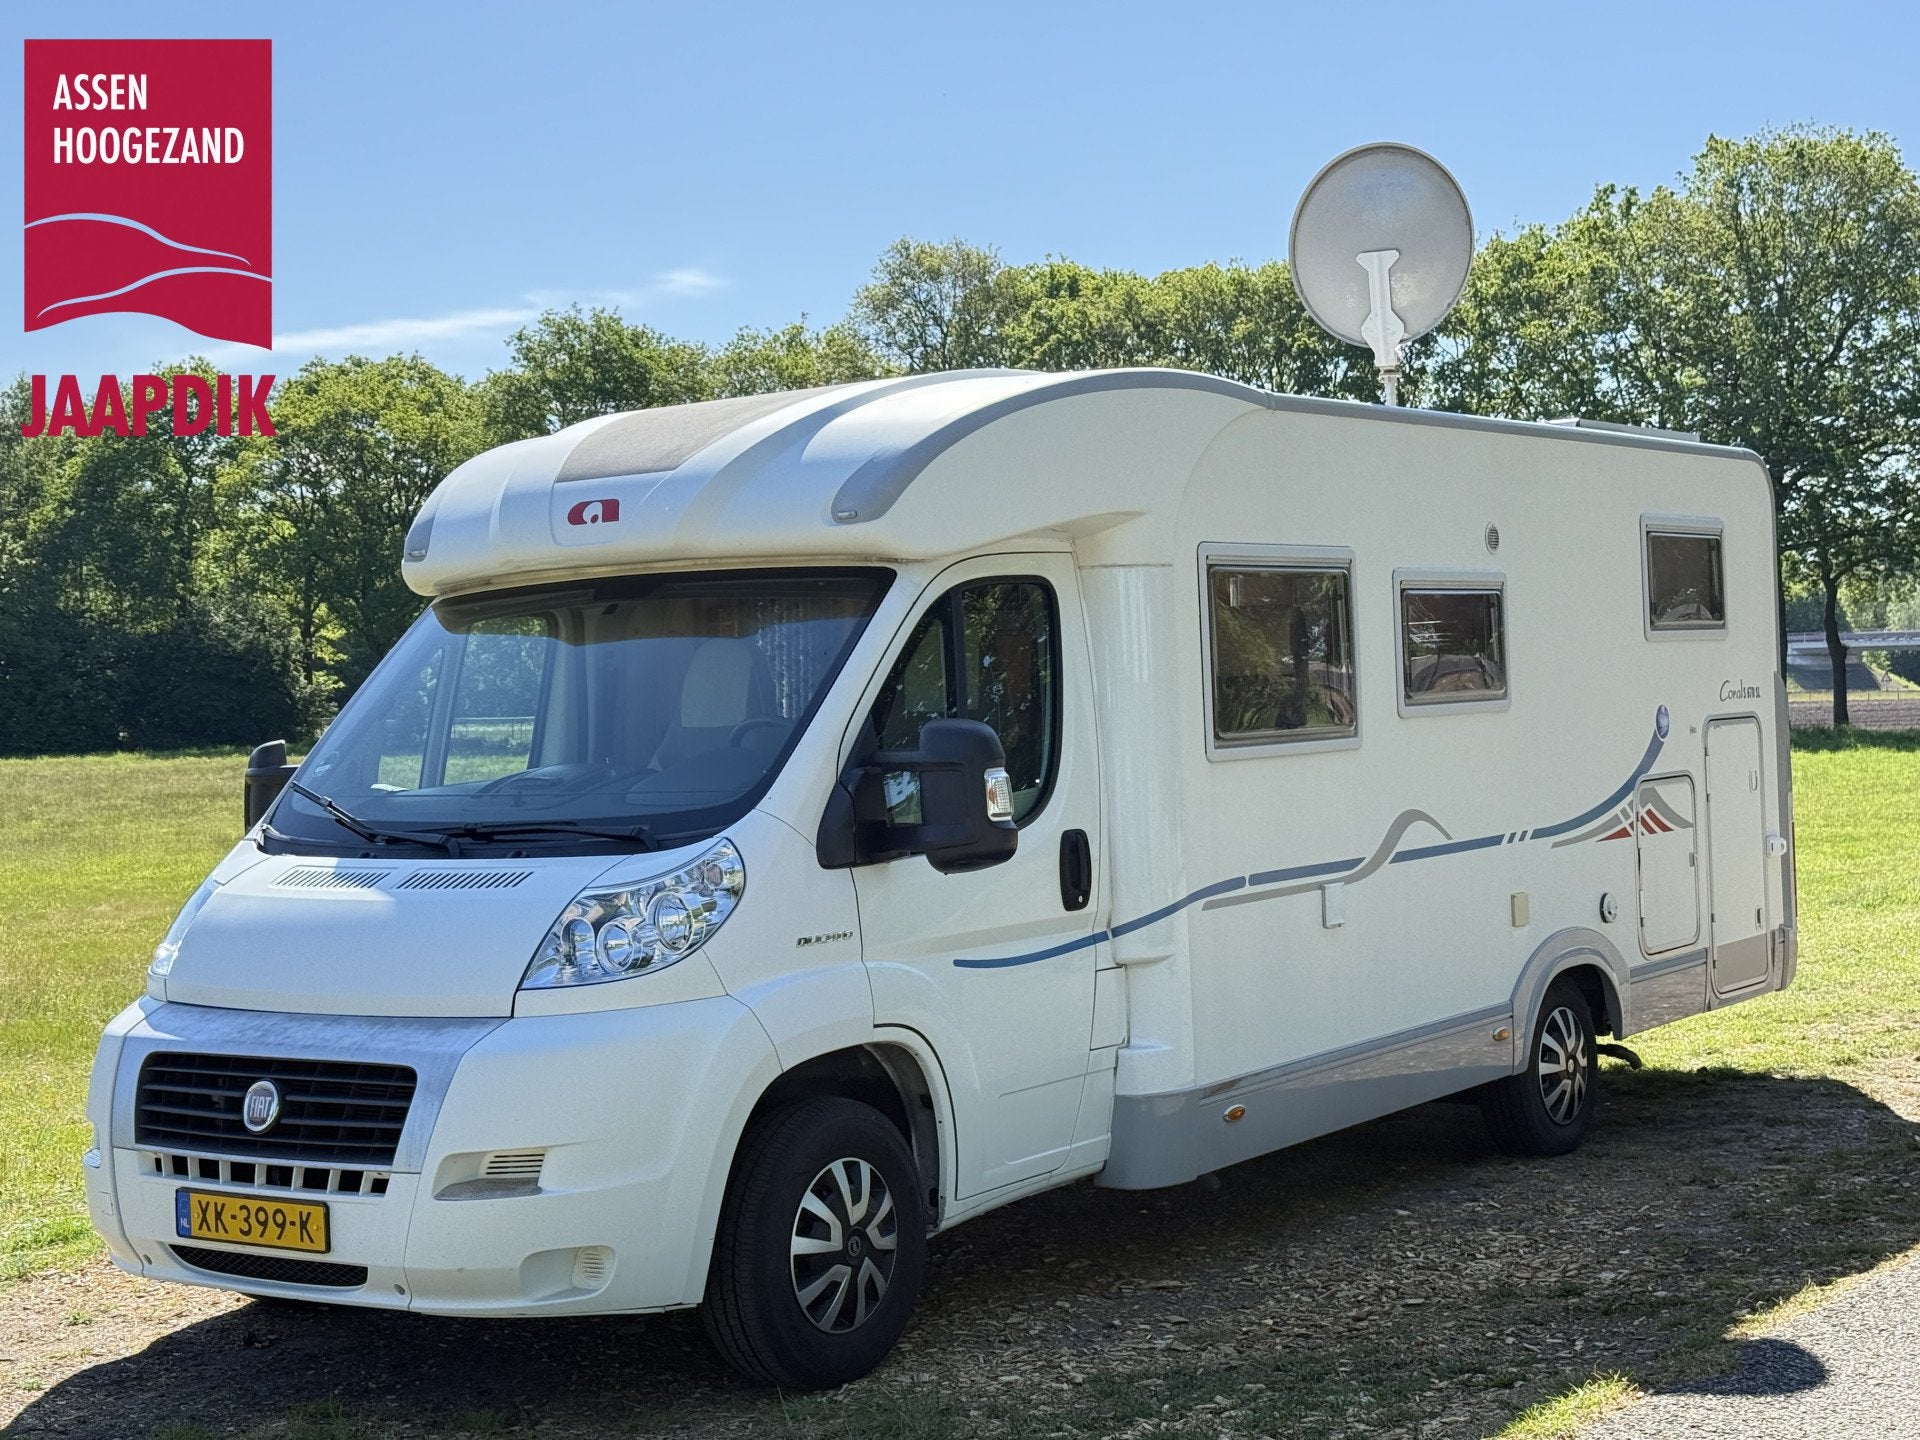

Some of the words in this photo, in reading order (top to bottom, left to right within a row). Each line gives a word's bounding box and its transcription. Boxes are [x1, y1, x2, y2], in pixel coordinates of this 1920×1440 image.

[250, 1096, 272, 1118] FIAT
[180, 1217, 190, 1228] NL
[197, 1199, 315, 1244] XK-399-K
